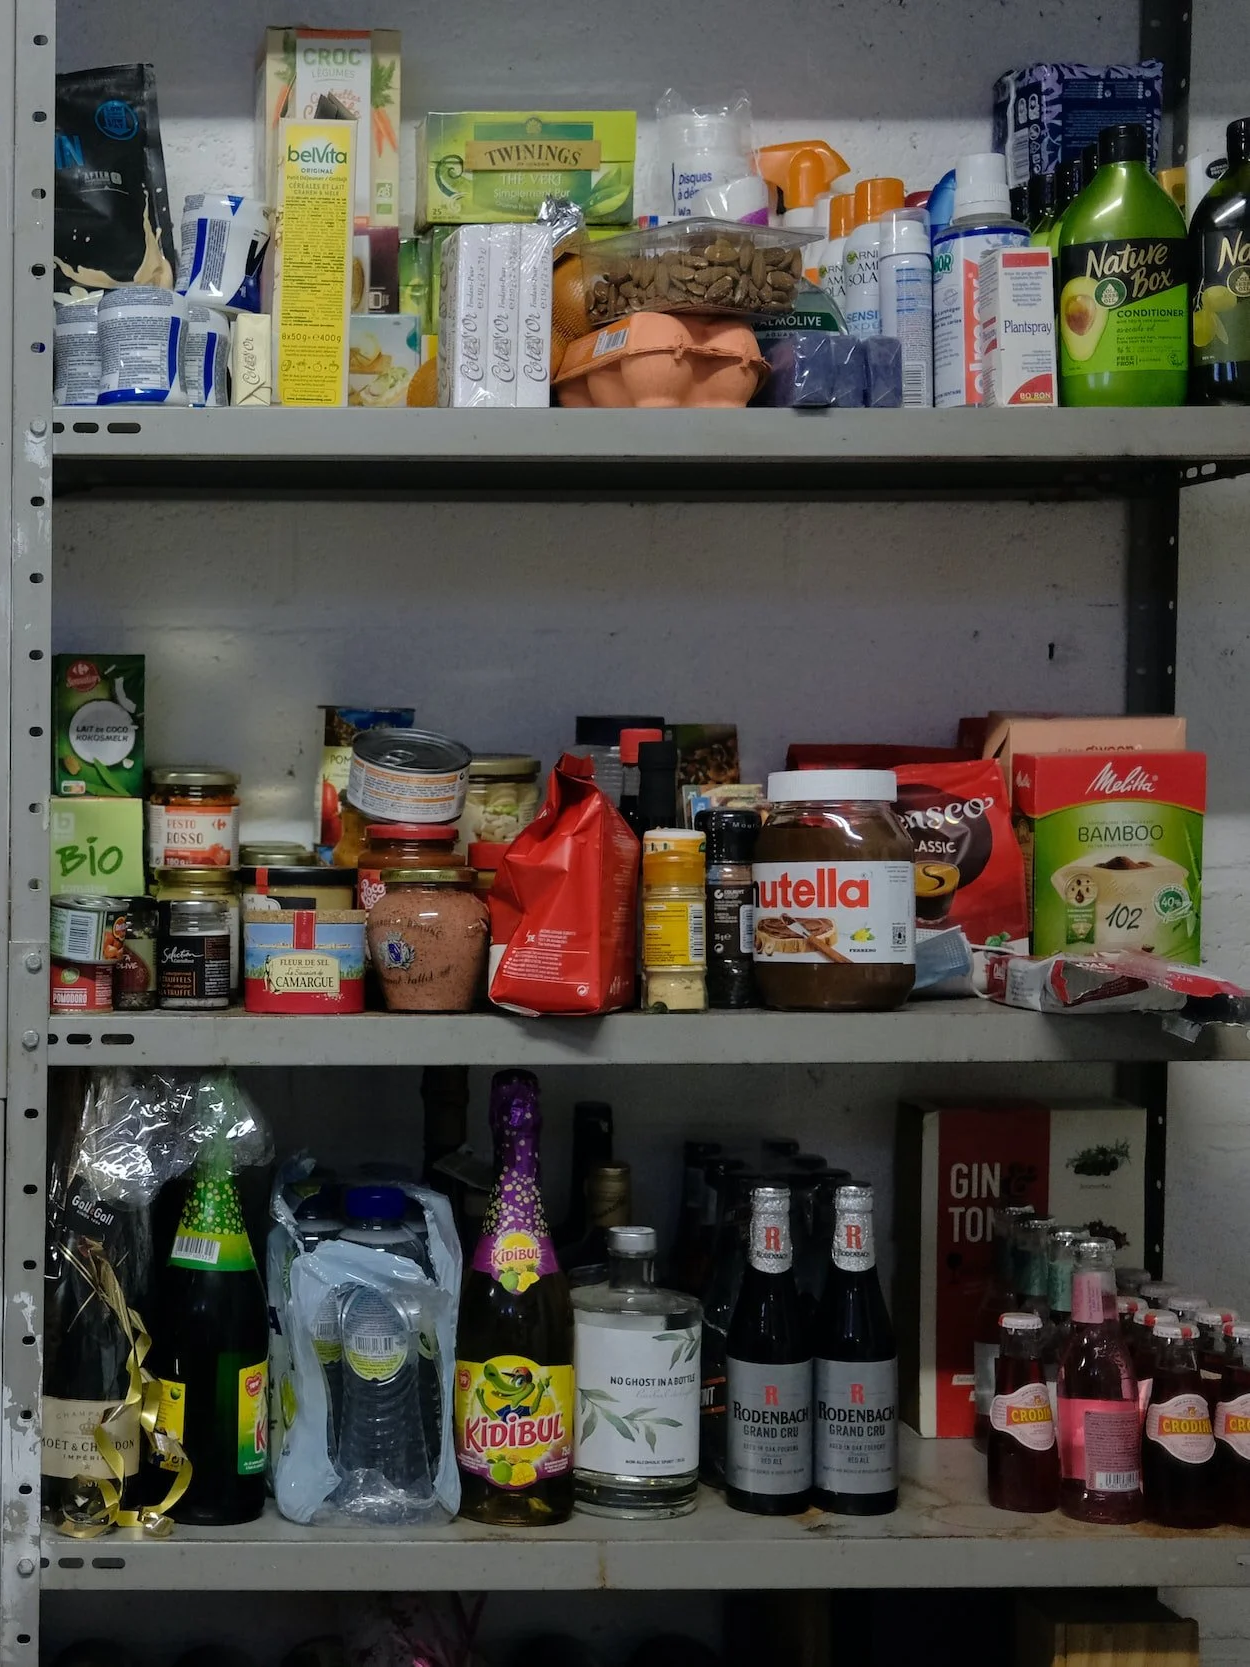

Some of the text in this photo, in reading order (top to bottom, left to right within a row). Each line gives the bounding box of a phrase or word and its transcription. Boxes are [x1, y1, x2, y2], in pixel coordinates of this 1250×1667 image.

[303, 48, 363, 67] CROC
[287, 142, 348, 165] belVita
[484, 143, 582, 167] TWININGS
[678, 171, 713, 186] Disques
[1085, 242, 1170, 280] Nature
[1131, 267, 1174, 299] Box
[754, 315, 823, 328] ALMOLIVE
[1116, 308, 1184, 319] CONDITIONER
[1003, 319, 1052, 336] Plantspray
[76, 725, 129, 733] LAIT COCO
[76, 734, 129, 742] KOKOSMELK
[1085, 761, 1156, 795] Melitta
[900, 796, 995, 831] enseo
[166, 832, 204, 845] ROSSO
[1077, 824, 1165, 843] BAMBOO
[915, 840, 957, 853] ASSIC
[752, 867, 870, 910] nutella
[1105, 903, 1144, 931] 102
[275, 976, 335, 988] CAMARGUE
[53, 992, 88, 1004] POMODORO
[950, 1162, 1001, 1200] GIN
[948, 1205, 998, 1244] TON
[763, 1226, 781, 1252] R
[845, 1223, 863, 1250] R
[610, 1375, 624, 1387] NO
[625, 1376, 656, 1388] GHOST
[657, 1376, 667, 1387] IN
[673, 1373, 696, 1386] BOTTLE
[763, 1384, 779, 1406] R
[850, 1383, 865, 1405] R
[733, 1400, 809, 1425] RODENBACH
[818, 1400, 896, 1423] RODENBACH
[743, 1424, 799, 1439] GRAND CRU
[829, 1424, 886, 1438] GRAND CRU
[1161, 1417, 1212, 1433] CRODIN
[81, 1439, 135, 1453] CHDON
